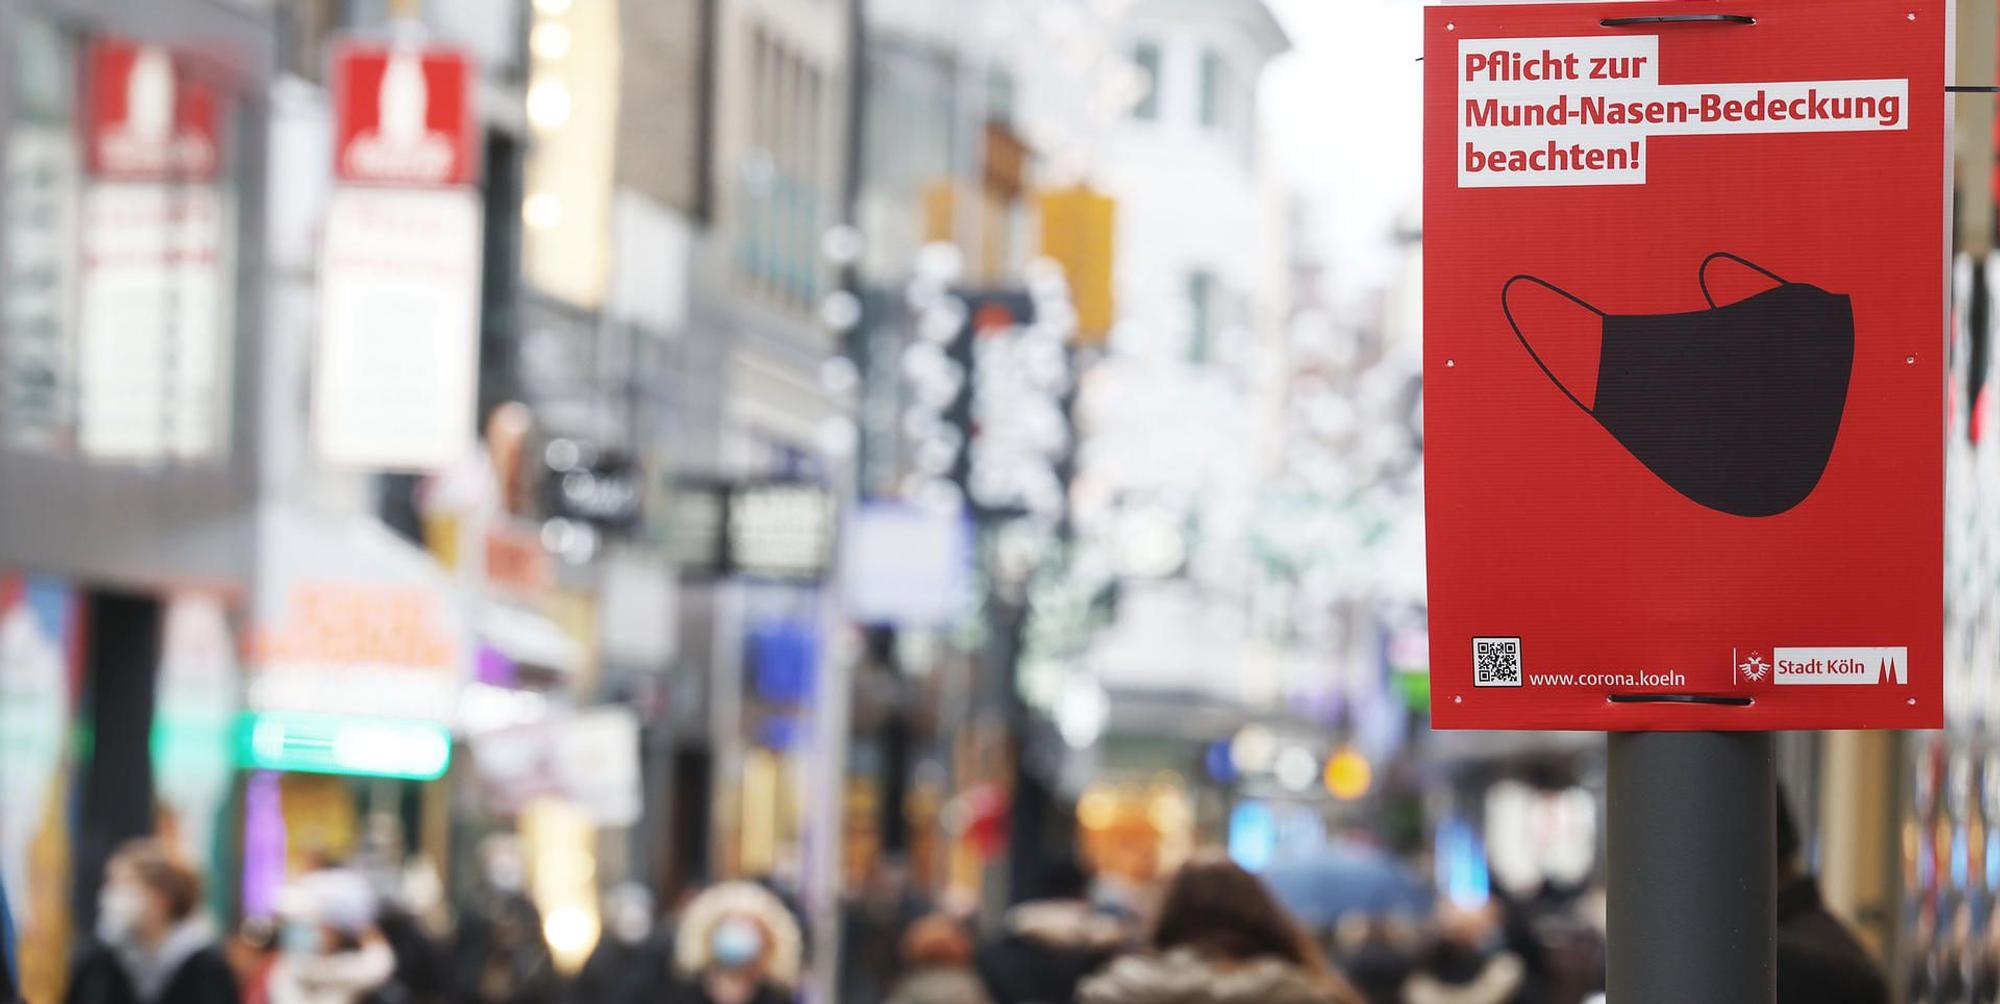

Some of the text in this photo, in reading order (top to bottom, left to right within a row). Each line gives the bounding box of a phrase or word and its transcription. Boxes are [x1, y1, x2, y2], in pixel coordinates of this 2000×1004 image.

[1465, 49, 1647, 82] Pflicht zur
[1465, 88, 1900, 127] Mund-Nasen-Bedeckung
[1464, 141, 1640, 173] beachten!
[1529, 669, 1686, 687] www.corona.koeln
[1777, 657, 1865, 675] Stadt Köln
